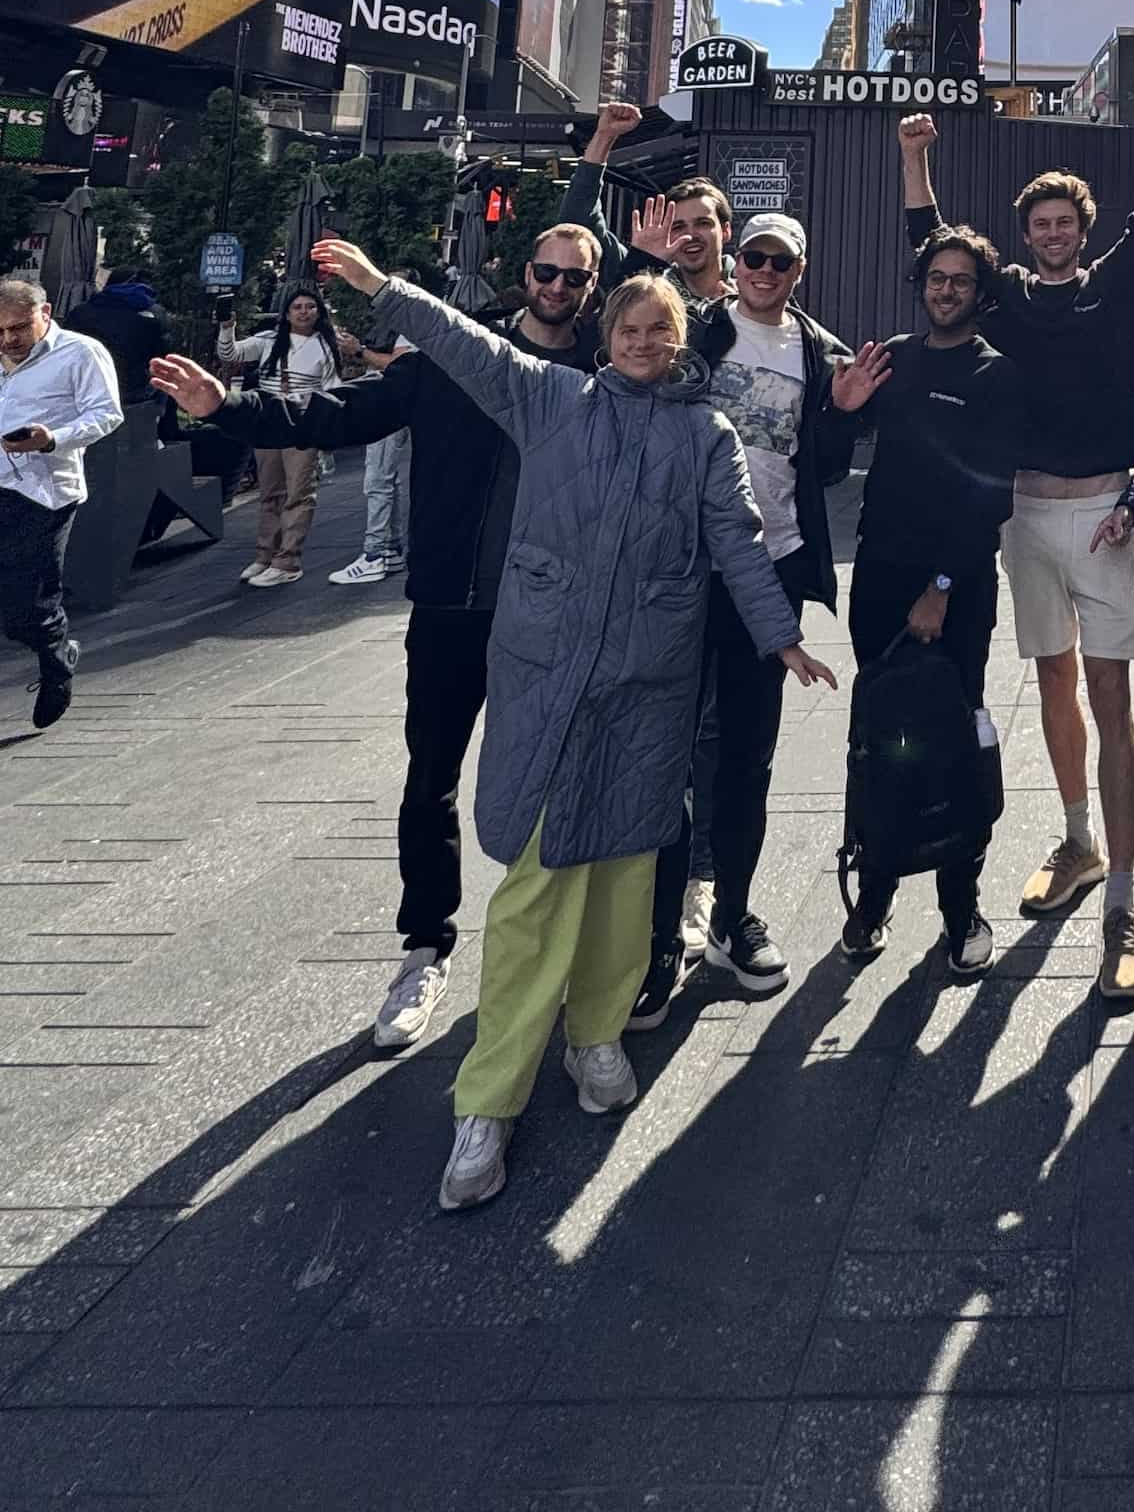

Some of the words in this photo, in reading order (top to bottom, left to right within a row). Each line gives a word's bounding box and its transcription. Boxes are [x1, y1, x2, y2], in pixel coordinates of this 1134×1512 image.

[284, 5, 342, 43] MENENDEZ
[281, 29, 338, 64] BROTHERS
[697, 42, 736, 62] BEER
[684, 64, 747, 83] GARDEN
[774, 88, 815, 100] best
[775, 73, 816, 85] NYC's
[823, 75, 978, 105] HOTDOGS
[738, 164, 780, 174] HOTDOGS
[732, 180, 786, 191] SANDWICHES
[736, 195, 778, 207] PANINIS
[207, 235, 239, 245] BEER
[207, 245, 234, 256] AND
[206, 255, 238, 265] WINE
[205, 266, 238, 276] AREA
